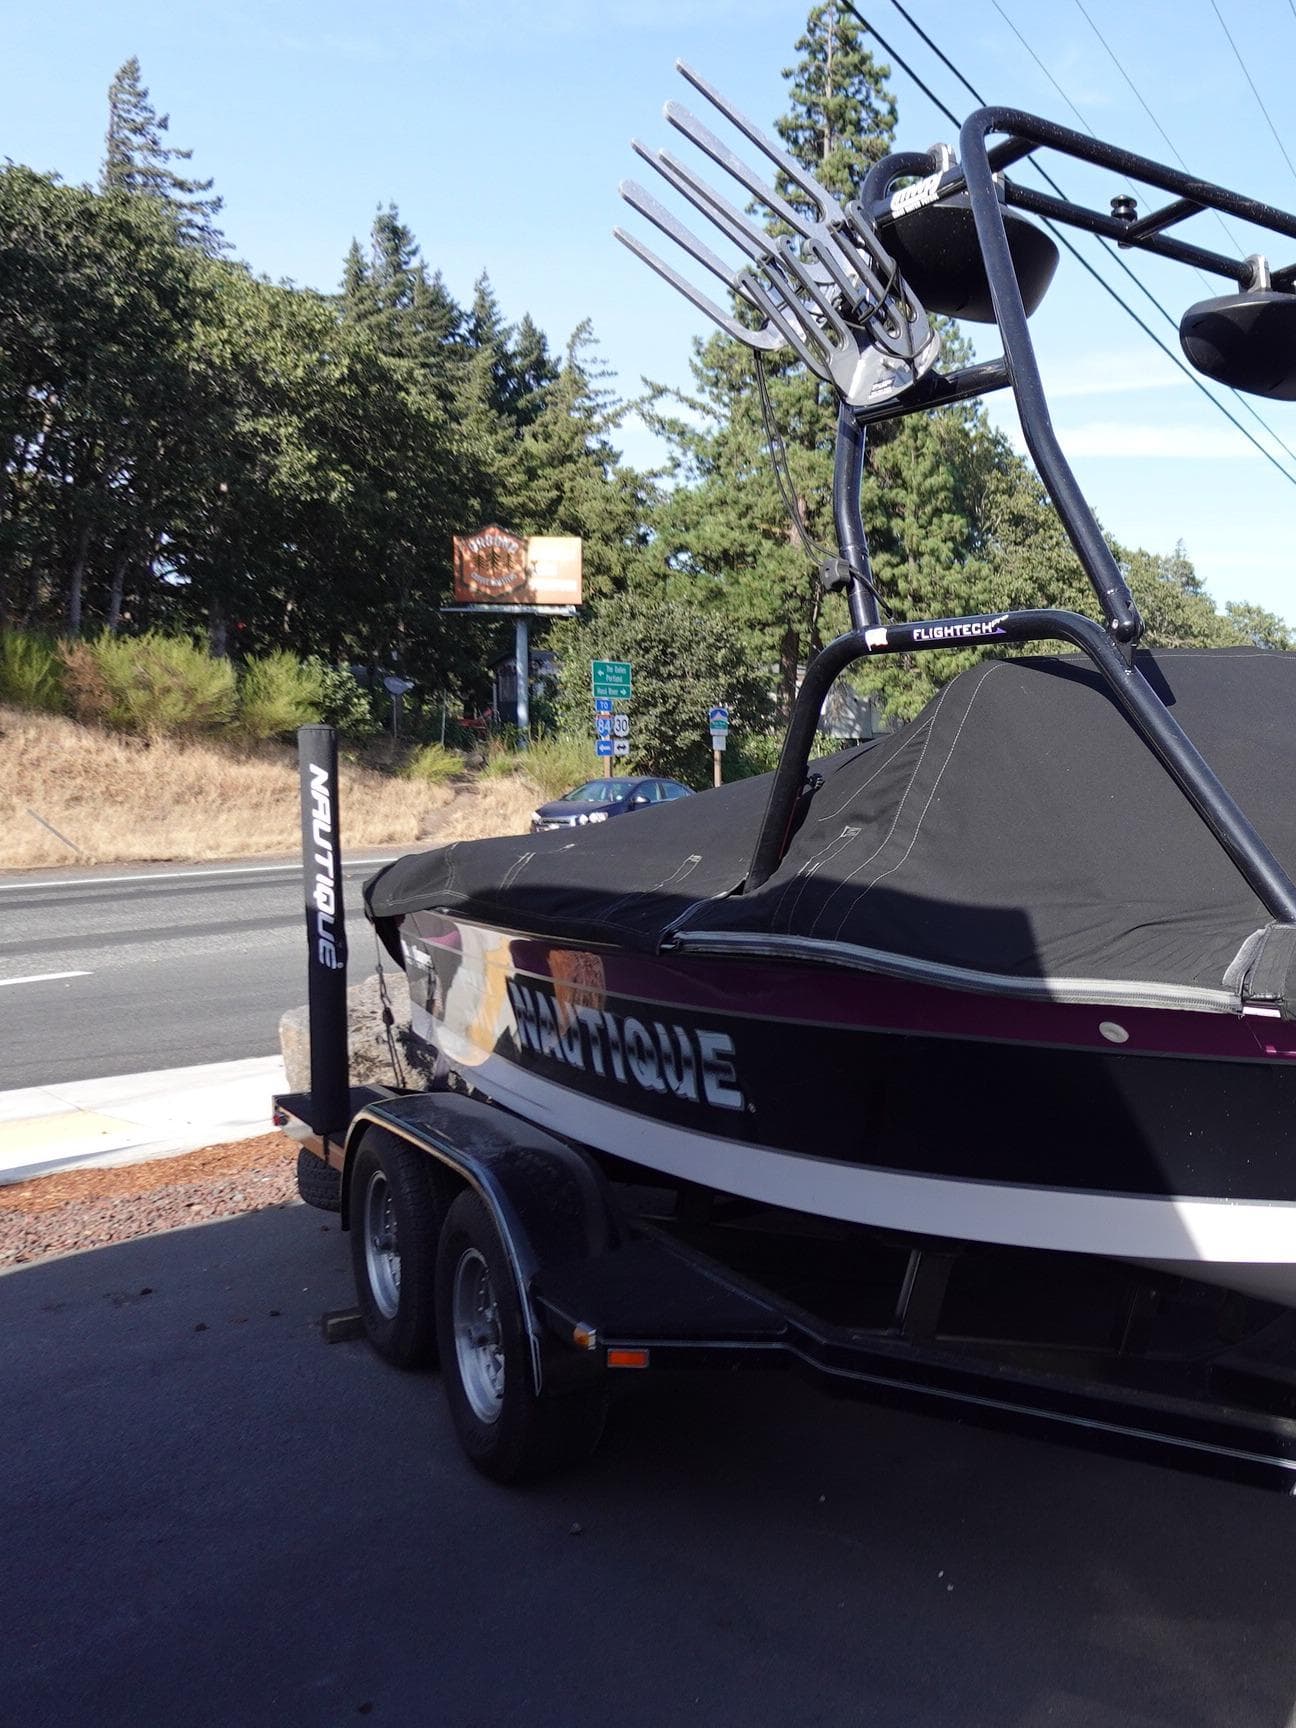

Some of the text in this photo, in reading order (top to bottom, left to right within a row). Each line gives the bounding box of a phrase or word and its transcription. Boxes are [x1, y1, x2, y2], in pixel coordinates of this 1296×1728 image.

[913, 619, 997, 640] FLIGHTECH
[600, 701, 609, 709] TO
[599, 718, 611, 733] 84
[615, 719, 627, 732] 30
[309, 763, 337, 970] NAUTIQUE
[507, 980, 745, 1111] NAUTIQUE
